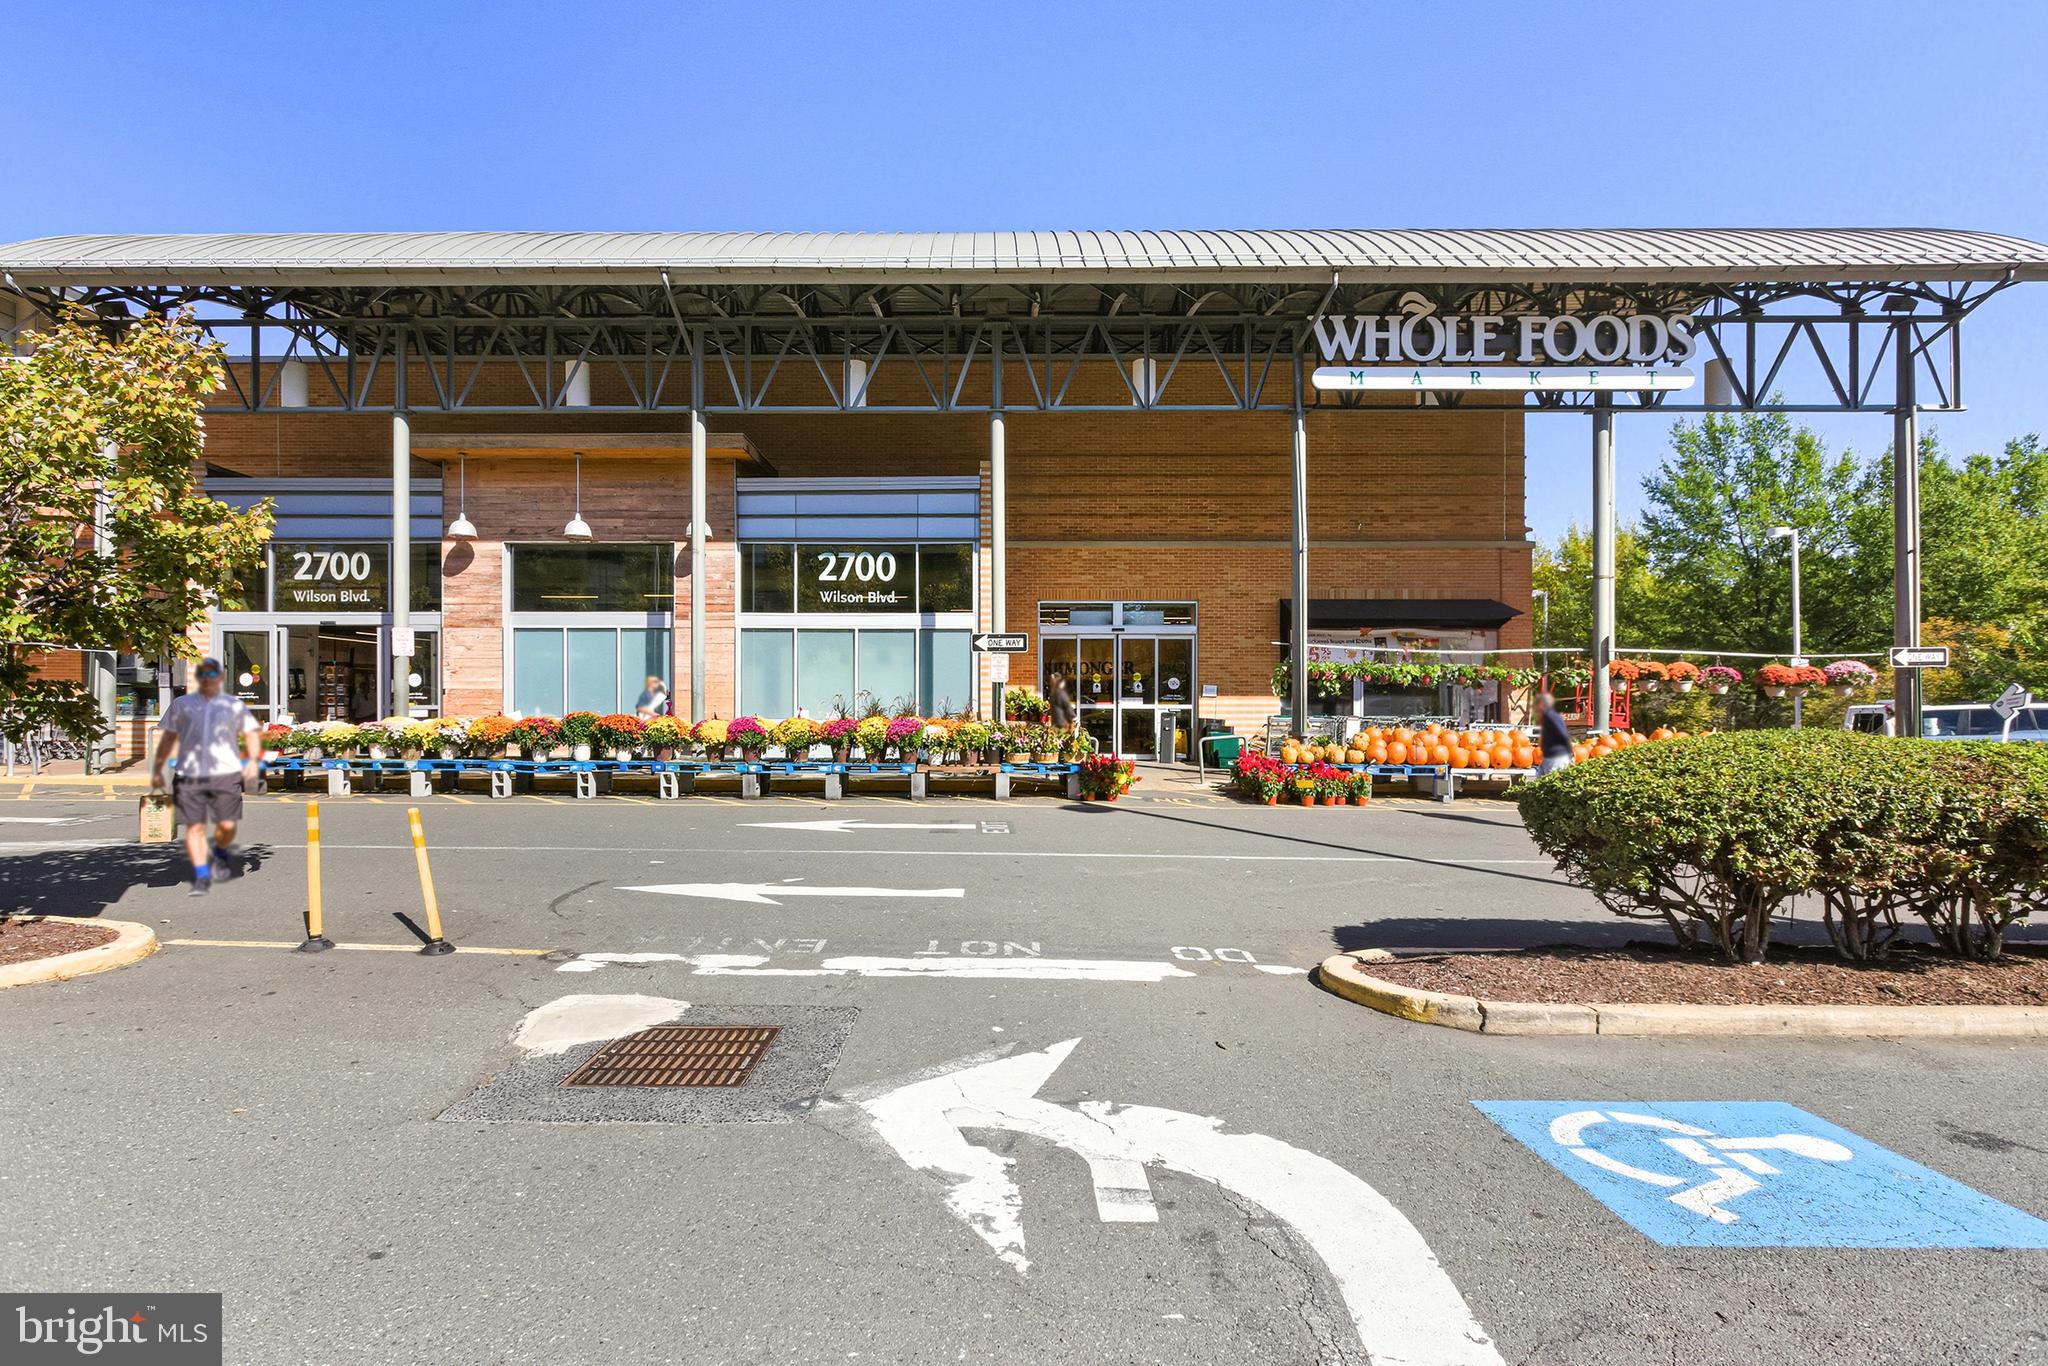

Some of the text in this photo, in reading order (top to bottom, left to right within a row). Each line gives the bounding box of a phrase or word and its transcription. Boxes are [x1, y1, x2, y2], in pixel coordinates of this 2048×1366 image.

[1307, 307, 1696, 362] WHOLE FOODS
[1349, 370, 1658, 386] MARKET
[293, 551, 371, 581] 2700
[817, 551, 897, 582] 2700
[293, 590, 371, 602] Wilson Blvd.
[820, 590, 898, 603] Wilson Blvd.
[988, 639, 1021, 647] ONE WAY
[912, 940, 1040, 956] NOT
[1170, 946, 1257, 963] DO
